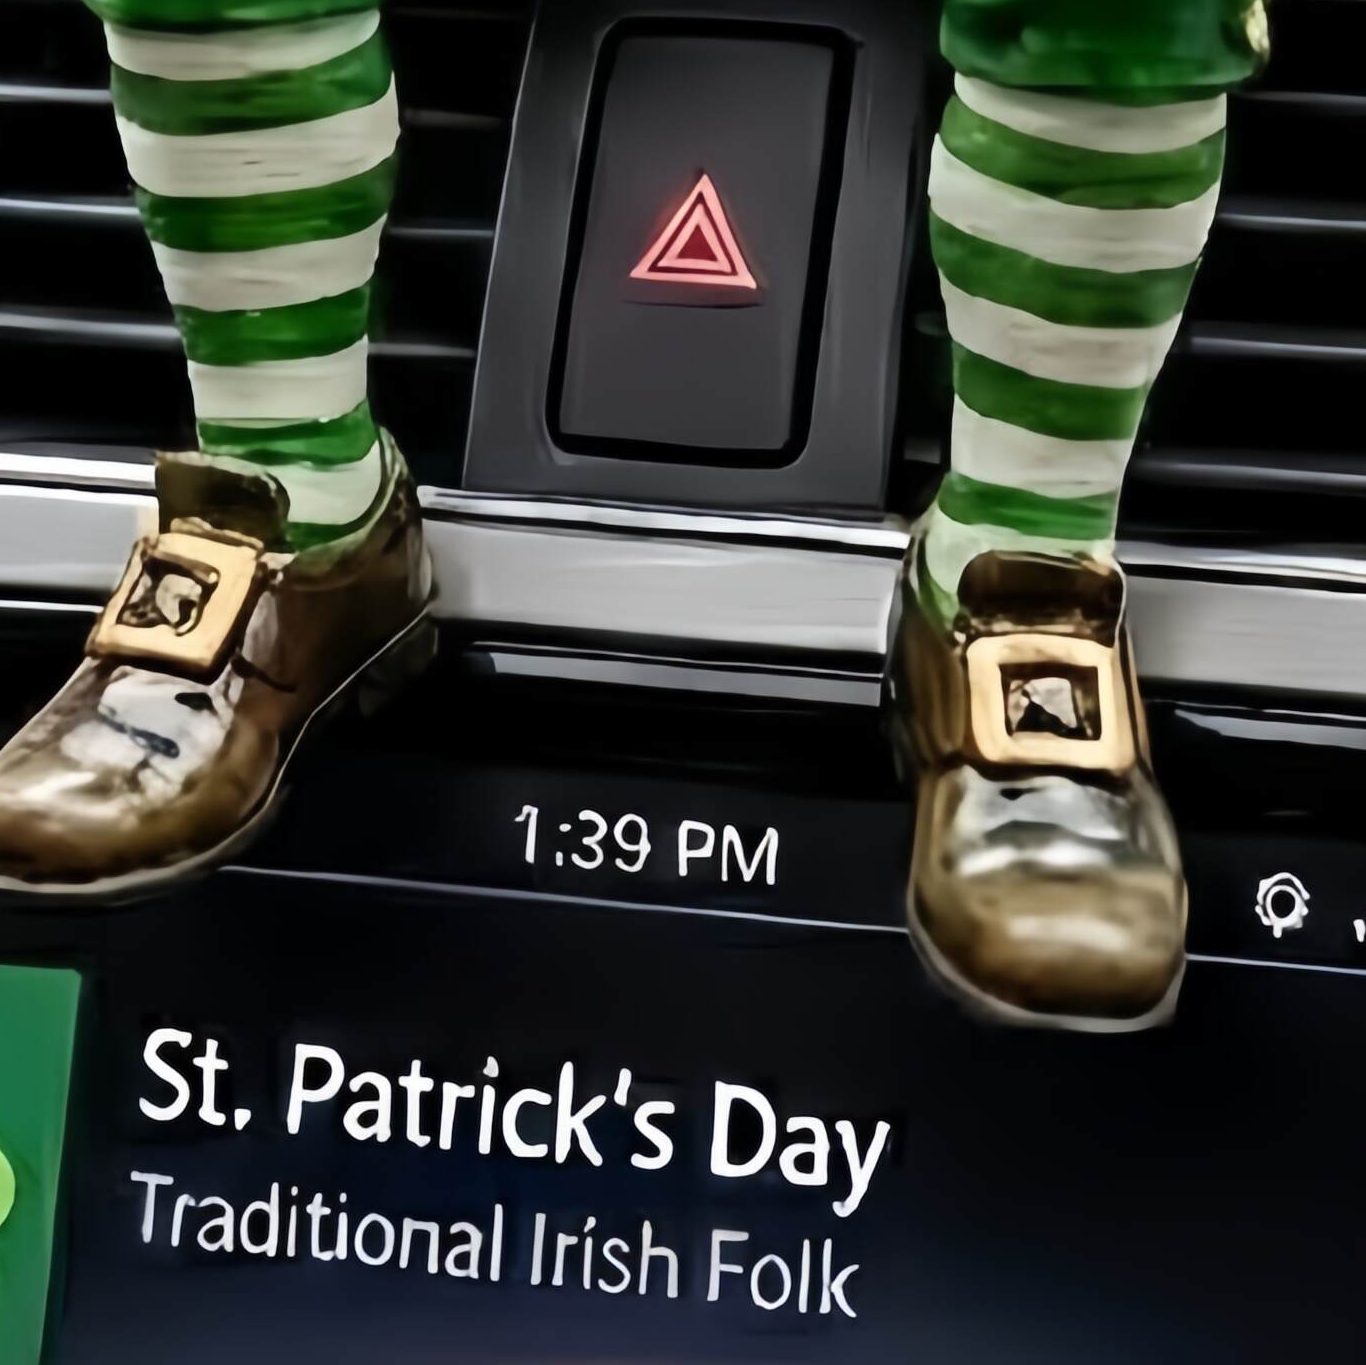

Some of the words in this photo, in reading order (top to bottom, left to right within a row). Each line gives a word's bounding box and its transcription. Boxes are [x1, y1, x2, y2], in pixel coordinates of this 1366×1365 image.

[514, 804, 653, 874] 1:39
[677, 819, 780, 886] PM
[138, 1027, 252, 1131] St.
[286, 1043, 676, 1170] Patrick's
[710, 1080, 891, 1218] Day
[130, 1170, 504, 1282] Traditional
[530, 1212, 679, 1299] Irish
[706, 1228, 860, 1318] Folk
